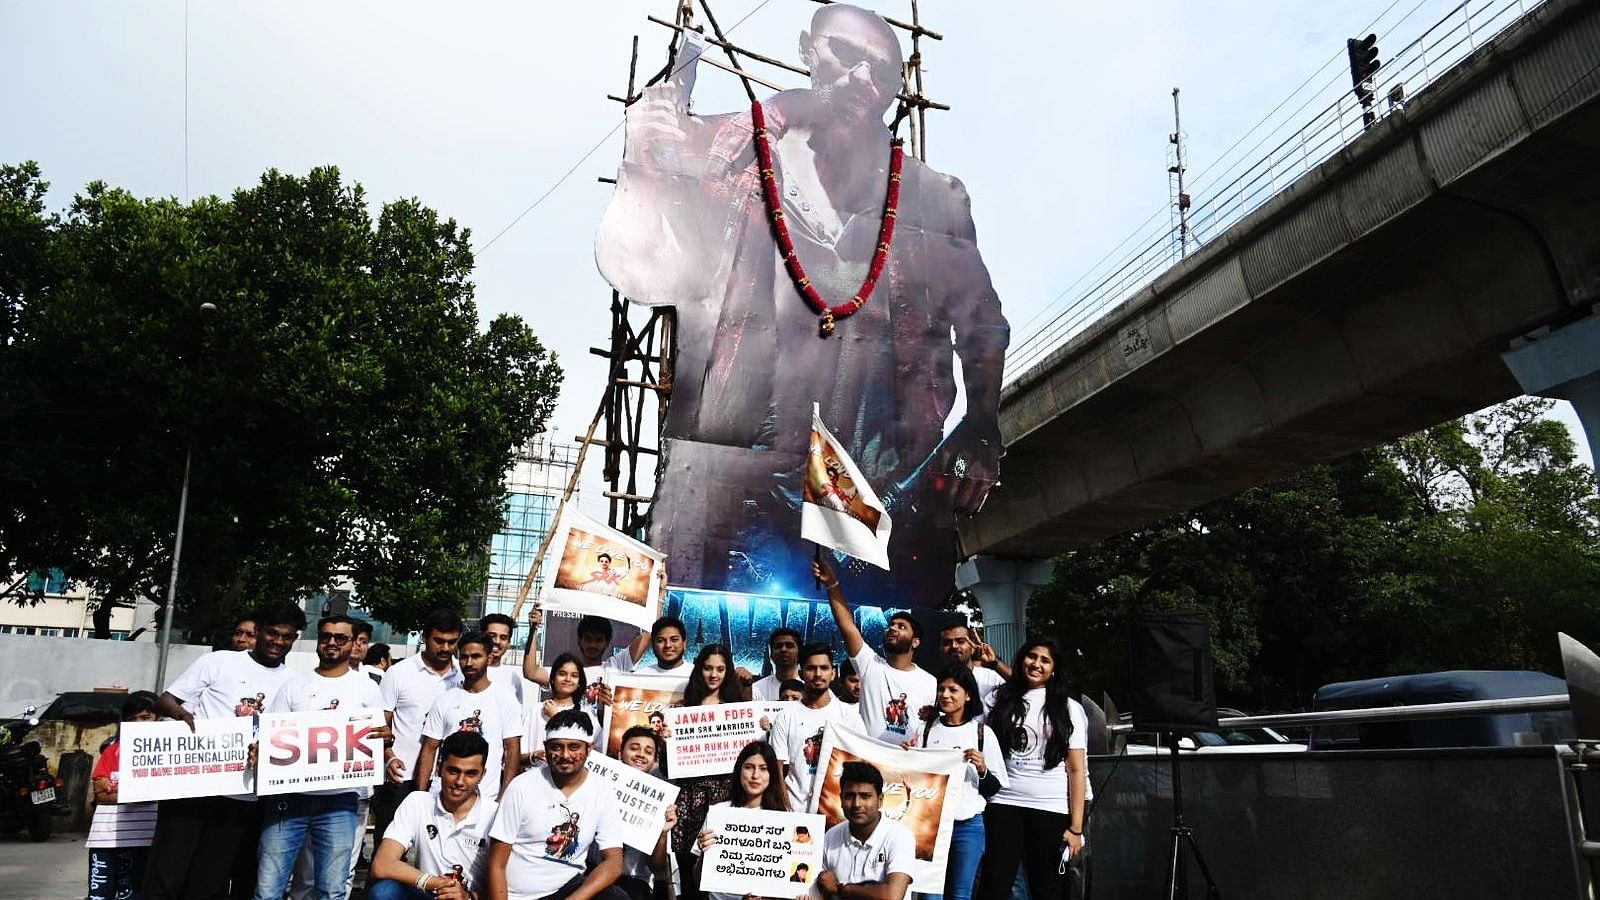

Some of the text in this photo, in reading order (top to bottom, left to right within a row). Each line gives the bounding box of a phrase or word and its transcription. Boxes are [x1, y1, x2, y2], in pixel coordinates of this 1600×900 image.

[675, 711, 715, 725] JAWAN
[724, 708, 753, 720] FDFS
[675, 727, 695, 736] TEAM
[698, 725, 713, 733] SRK
[716, 722, 755, 731] WARRIORS
[133, 732, 244, 753] SHAH RUKH SIR
[269, 724, 374, 766] SRK
[676, 743, 701, 754] SHAH
[704, 741, 730, 751] RUKH
[132, 749, 245, 767] COME TO BENGALURU
[343, 760, 375, 773] FAN
[587, 760, 666, 802] SRK'S JAWAN
[615, 789, 658, 817] BUSTER
[619, 808, 653, 831] LURU
[765, 826, 785, 836] ಸರ್
[772, 840, 792, 855] ಬನ್ನಿ
[719, 850, 745, 865] ನಿಮ್ಮ
[745, 851, 783, 864] ಸೂಪರ್
[91, 853, 108, 890] Hello
[716, 863, 786, 879] ಅಭಿಮಾನಿಗಳು
